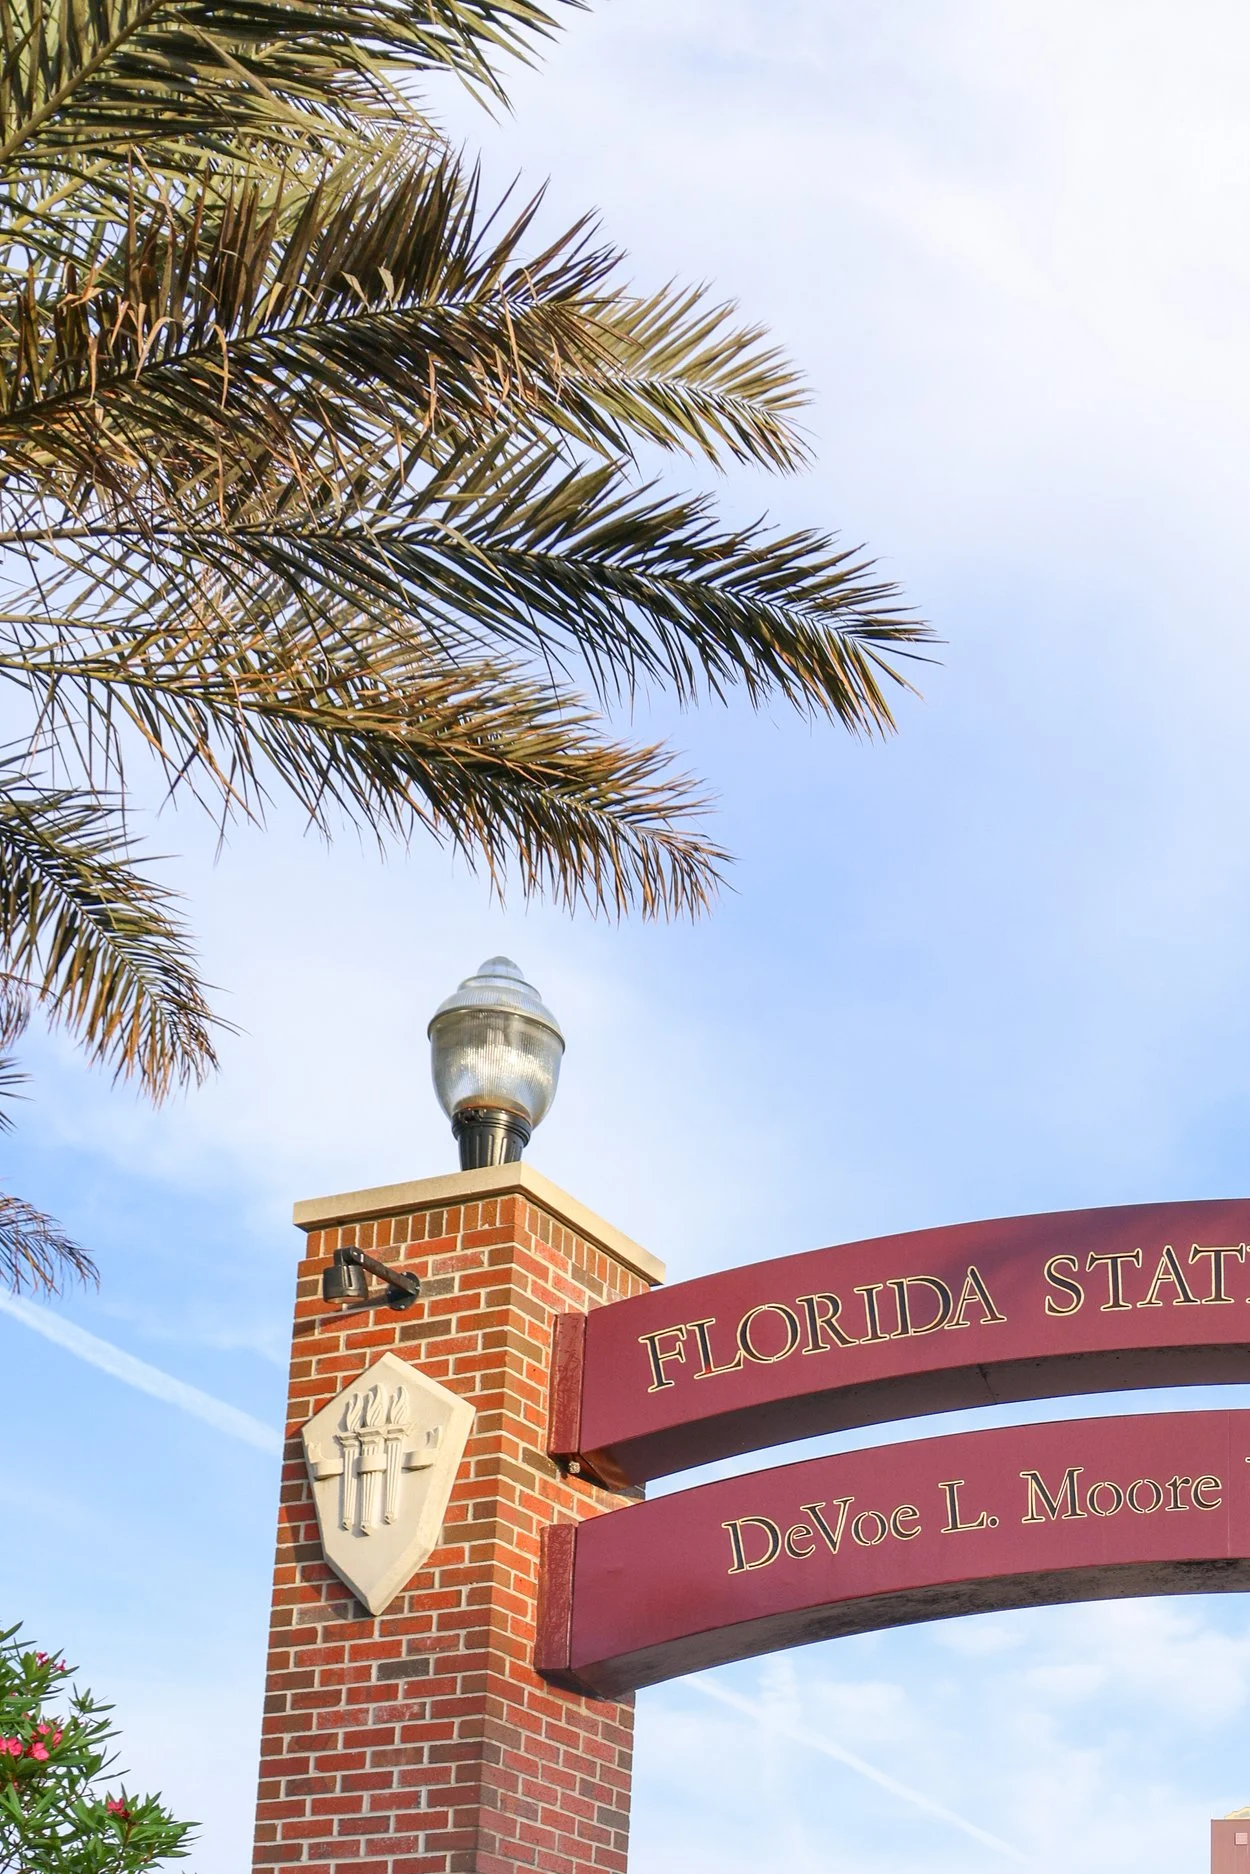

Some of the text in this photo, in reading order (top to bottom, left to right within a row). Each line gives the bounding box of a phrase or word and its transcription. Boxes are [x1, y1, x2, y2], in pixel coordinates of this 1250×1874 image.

[638, 1265, 1007, 1393] FLORIDA
[721, 1496, 921, 1574] DeVoe
[938, 1479, 999, 1534] L.
[1019, 1467, 1222, 1524] Moore
